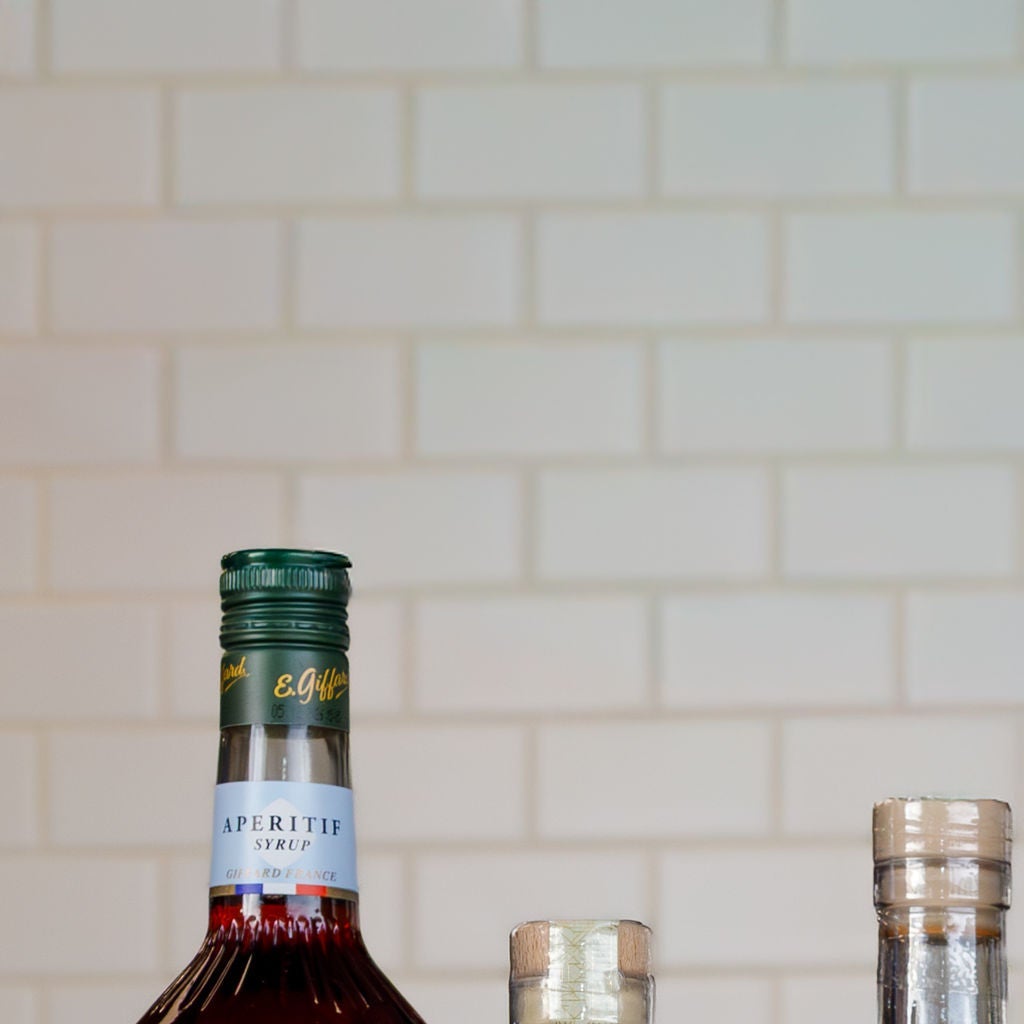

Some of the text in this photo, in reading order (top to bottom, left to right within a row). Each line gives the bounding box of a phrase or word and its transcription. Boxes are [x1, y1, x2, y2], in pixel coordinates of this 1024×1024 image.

[222, 815, 341, 836] APERITIF
[254, 838, 311, 851] SYRUP
[226, 868, 337, 882] GIFFARD FRANCE
